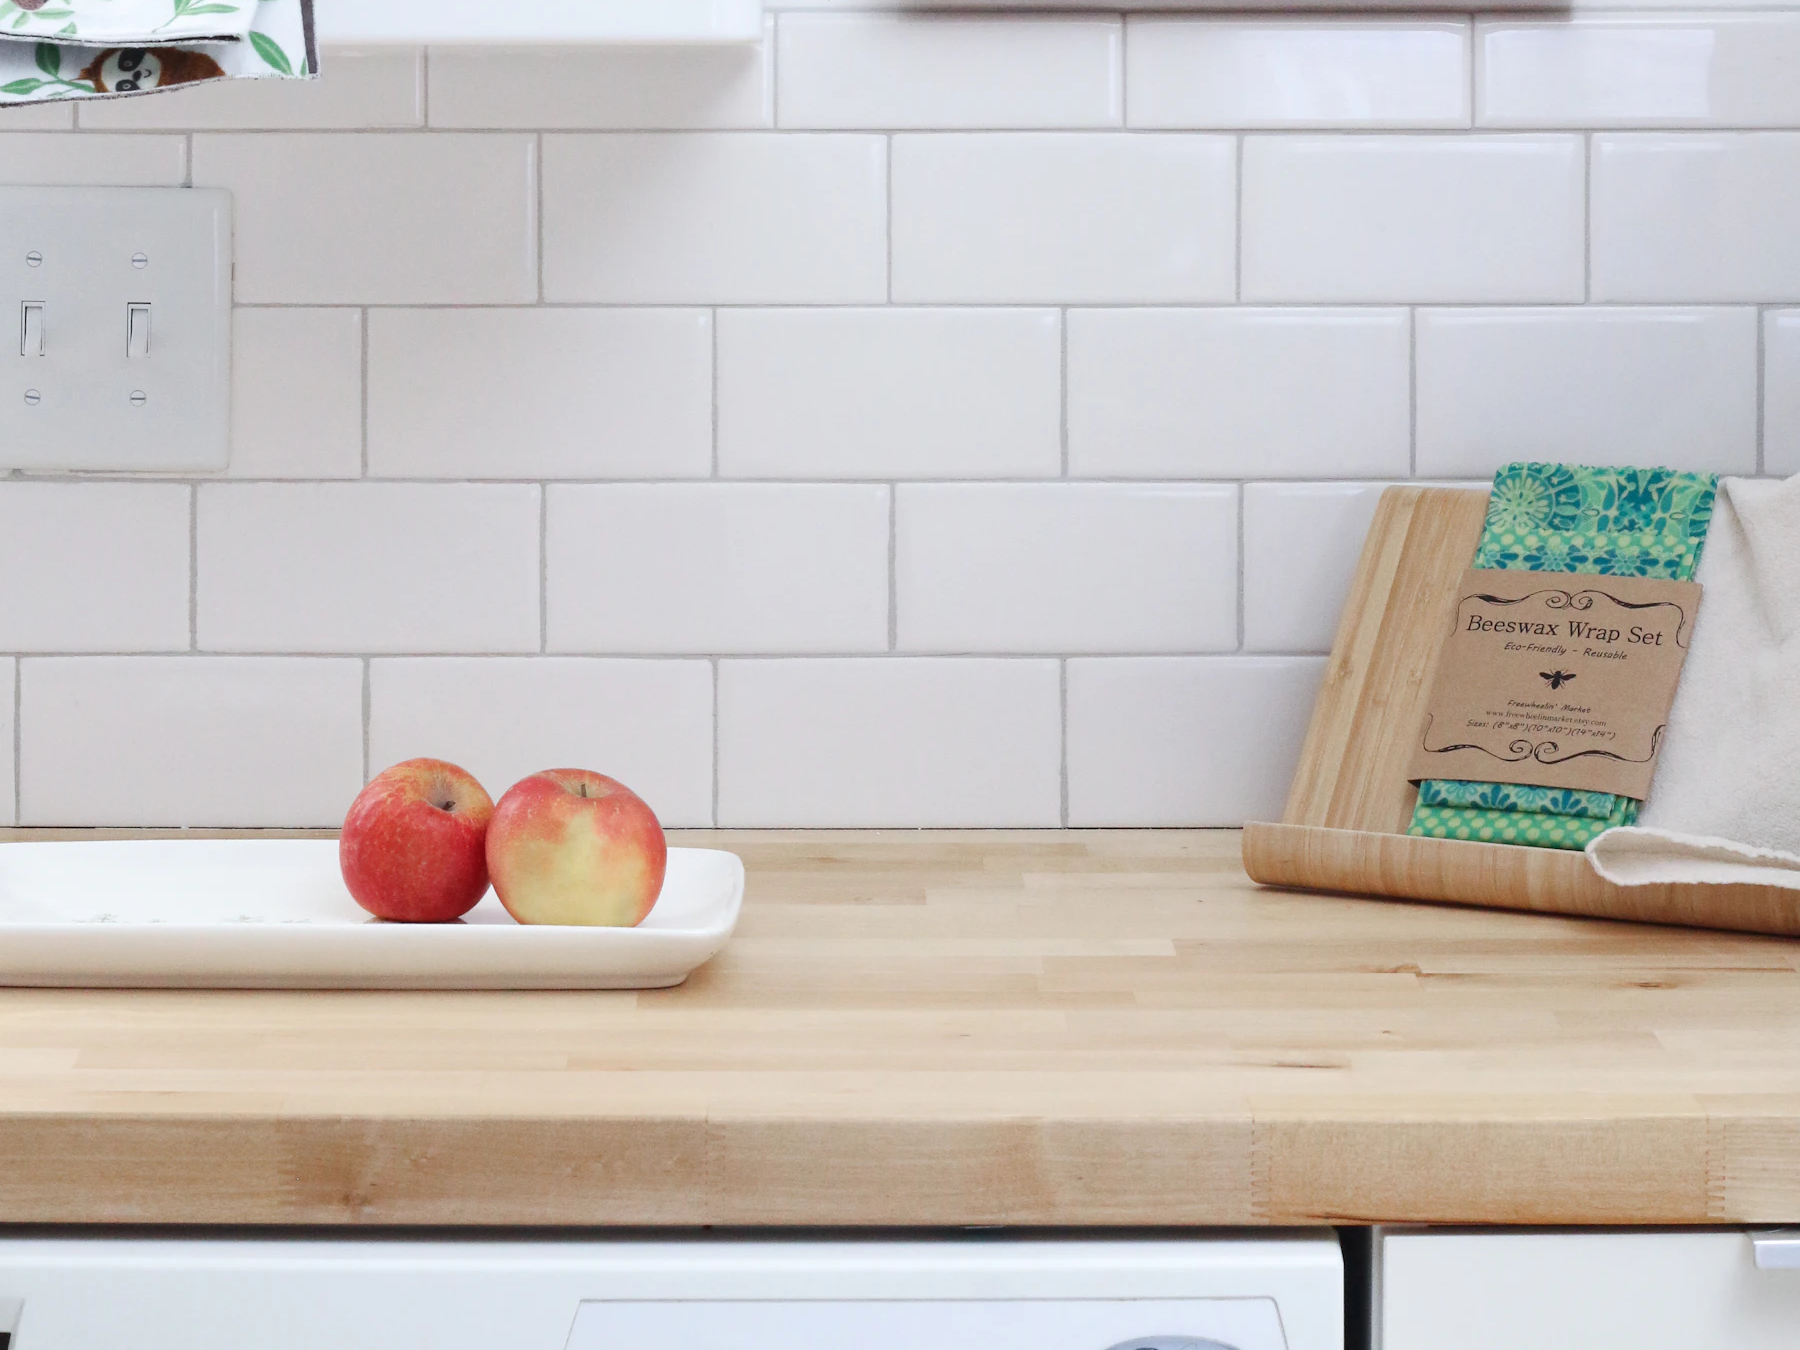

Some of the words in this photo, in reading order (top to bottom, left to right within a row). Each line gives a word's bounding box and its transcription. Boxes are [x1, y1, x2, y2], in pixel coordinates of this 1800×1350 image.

[1466, 614, 1560, 636] Beeswax
[1568, 620, 1620, 644] Wrap
[1627, 626, 1664, 646] Set
[1504, 641, 1568, 656] Eco-Friendly
[1583, 647, 1628, 661] Reusable
[1561, 704, 1592, 714] Market
[1466, 719, 1490, 728] Sizes:
